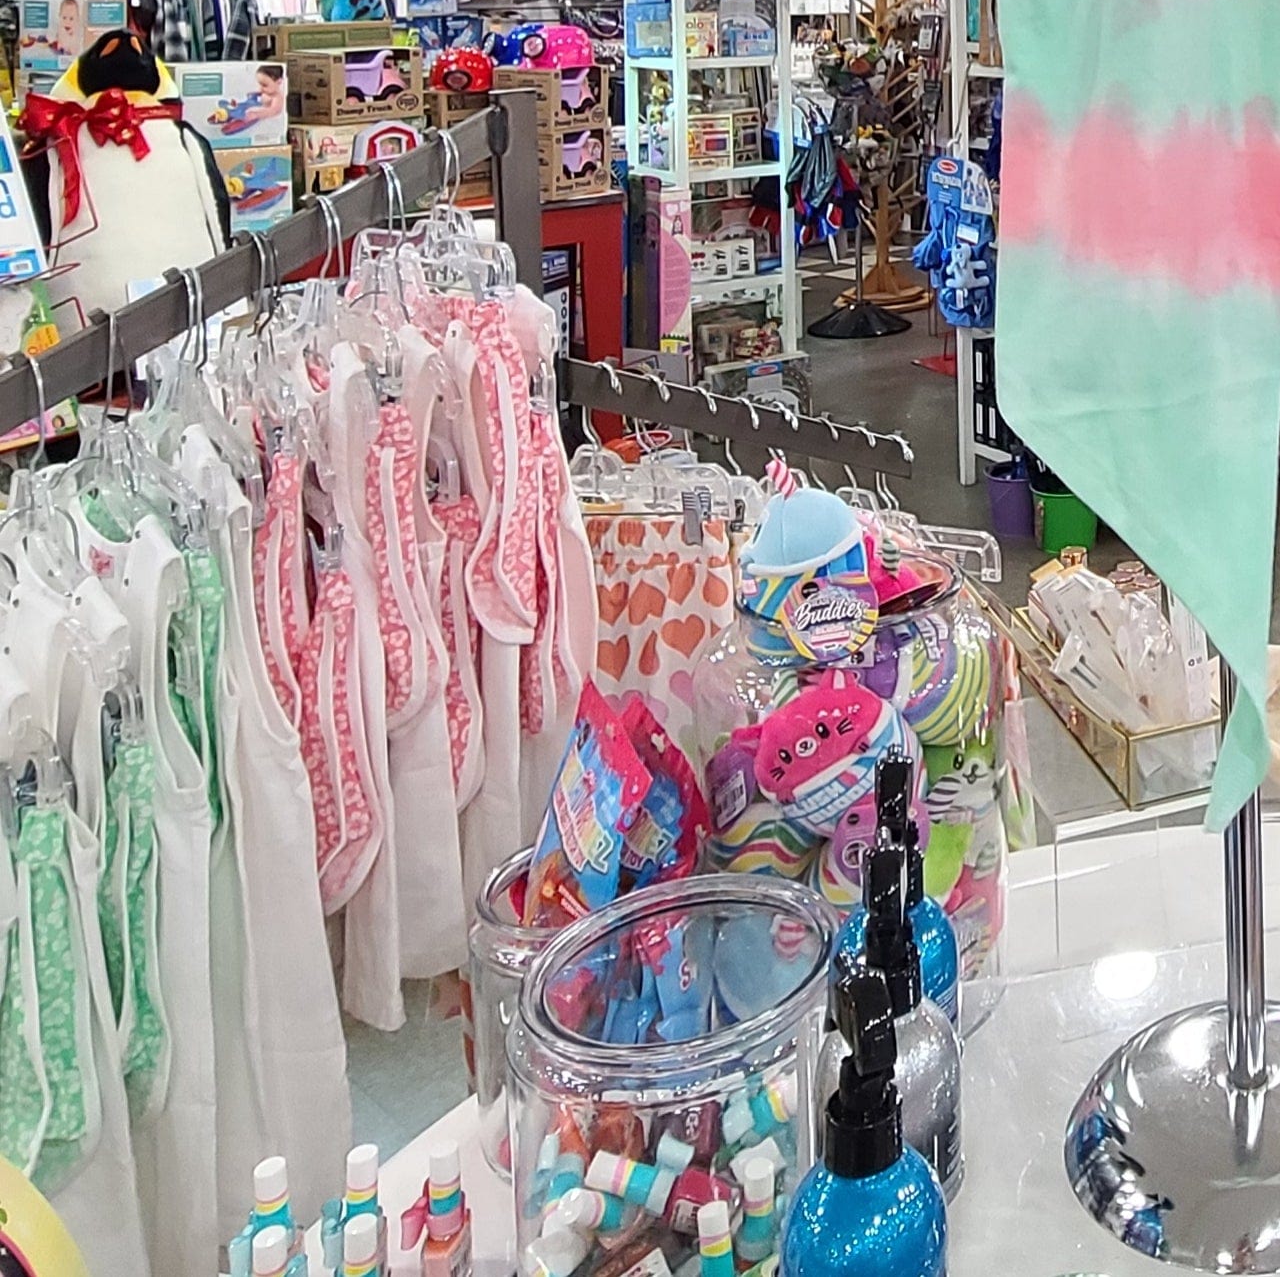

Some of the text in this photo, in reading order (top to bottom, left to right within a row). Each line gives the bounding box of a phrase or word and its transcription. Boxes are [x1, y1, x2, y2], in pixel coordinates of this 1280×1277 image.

[336, 105, 393, 117] Dump Truck
[795, 599, 864, 631] Buddies
